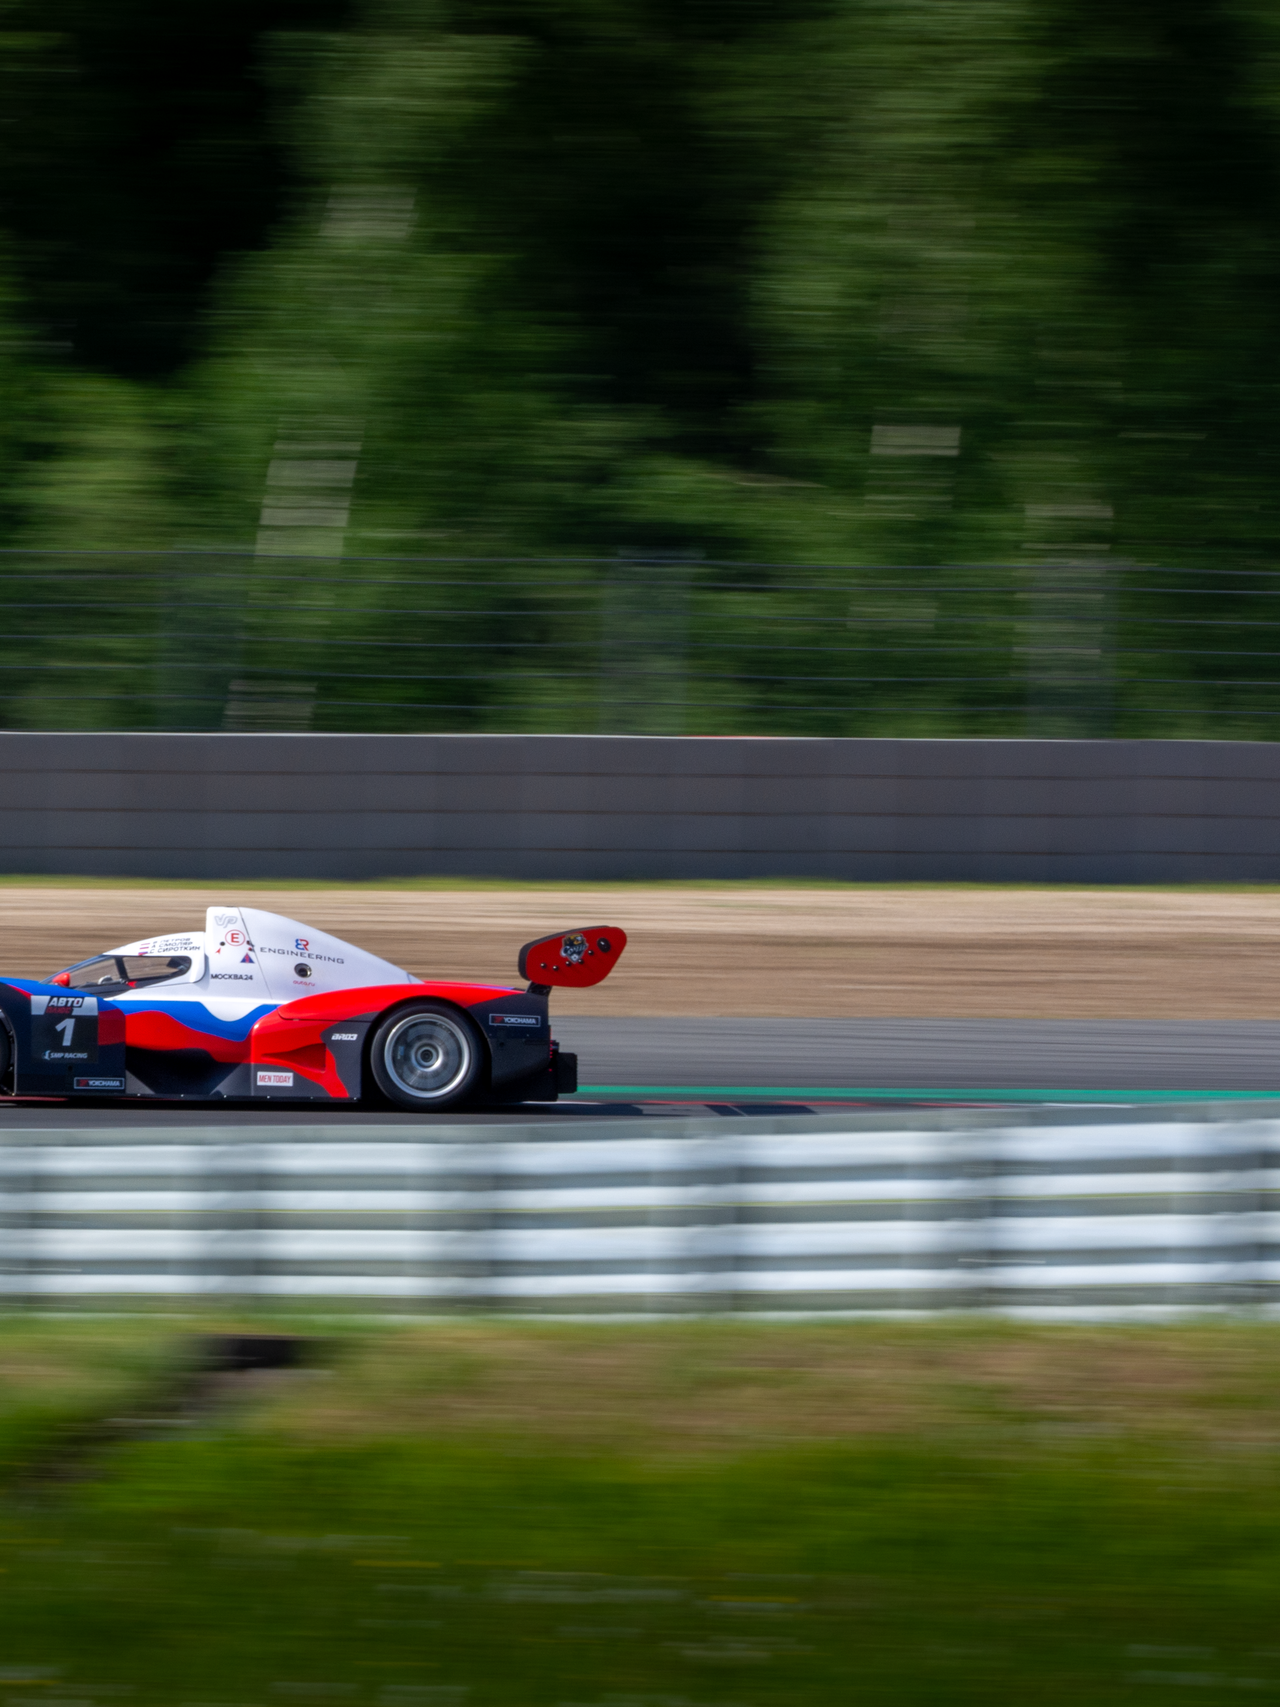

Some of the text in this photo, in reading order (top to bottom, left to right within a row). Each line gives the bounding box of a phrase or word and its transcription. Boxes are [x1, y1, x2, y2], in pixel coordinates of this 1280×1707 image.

[231, 933, 240, 943] E
[259, 946, 345, 965] ENGINEERING
[503, 1017, 537, 1025] YOKOHAMA
[55, 1018, 76, 1047] 1
[258, 1074, 292, 1084] MEN TODAY
